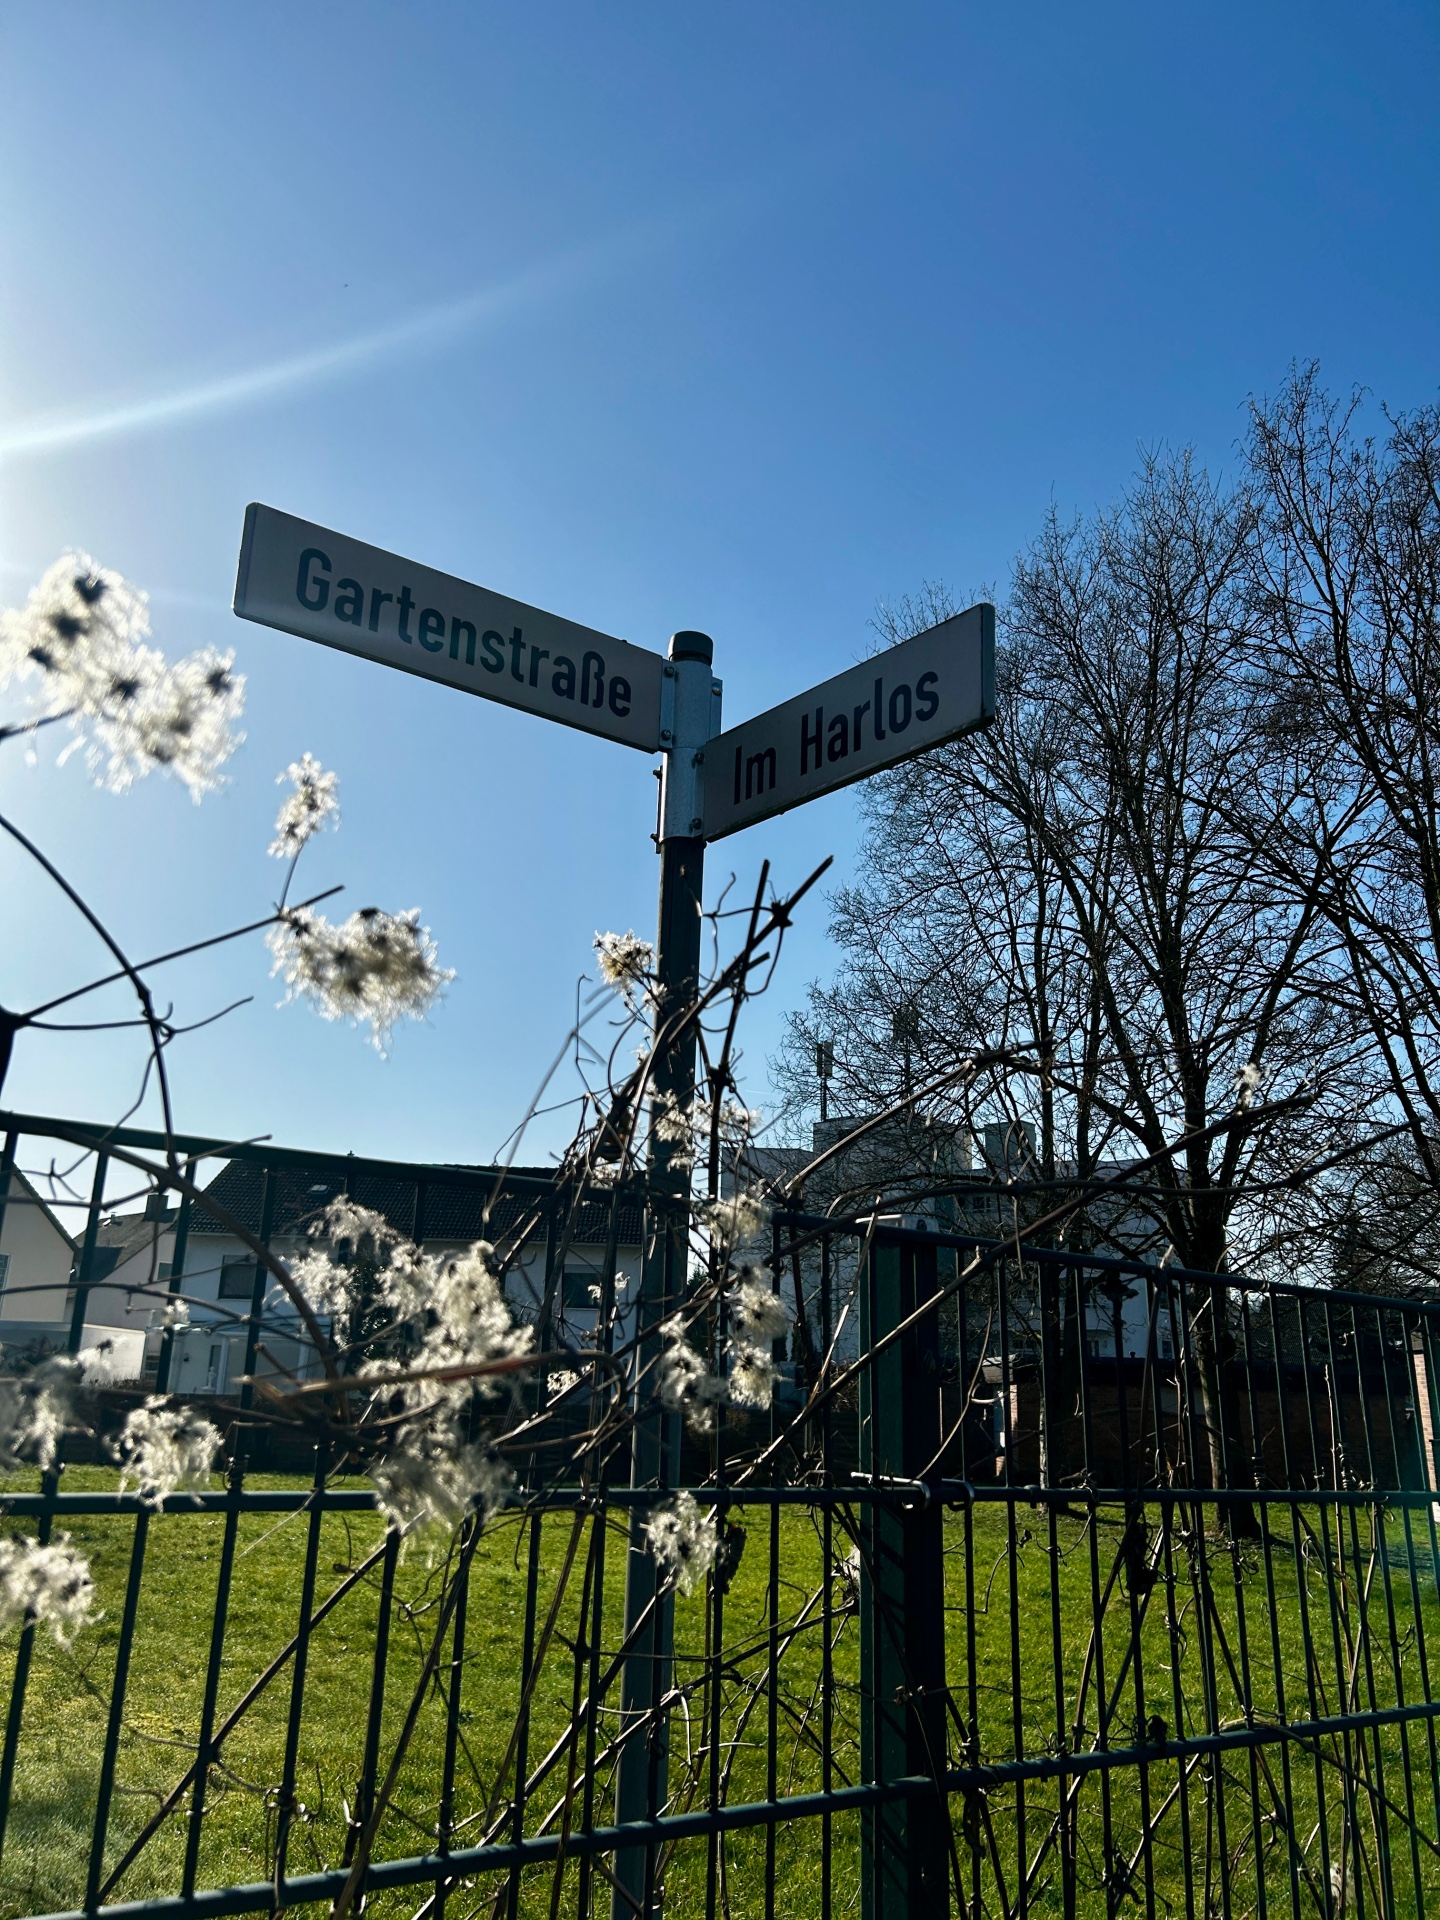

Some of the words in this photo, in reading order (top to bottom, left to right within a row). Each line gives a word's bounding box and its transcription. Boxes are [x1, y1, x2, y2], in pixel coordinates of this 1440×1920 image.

[296, 547, 632, 717] Gartenstraße
[733, 745, 777, 805] Im
[800, 671, 939, 776] Harlos
